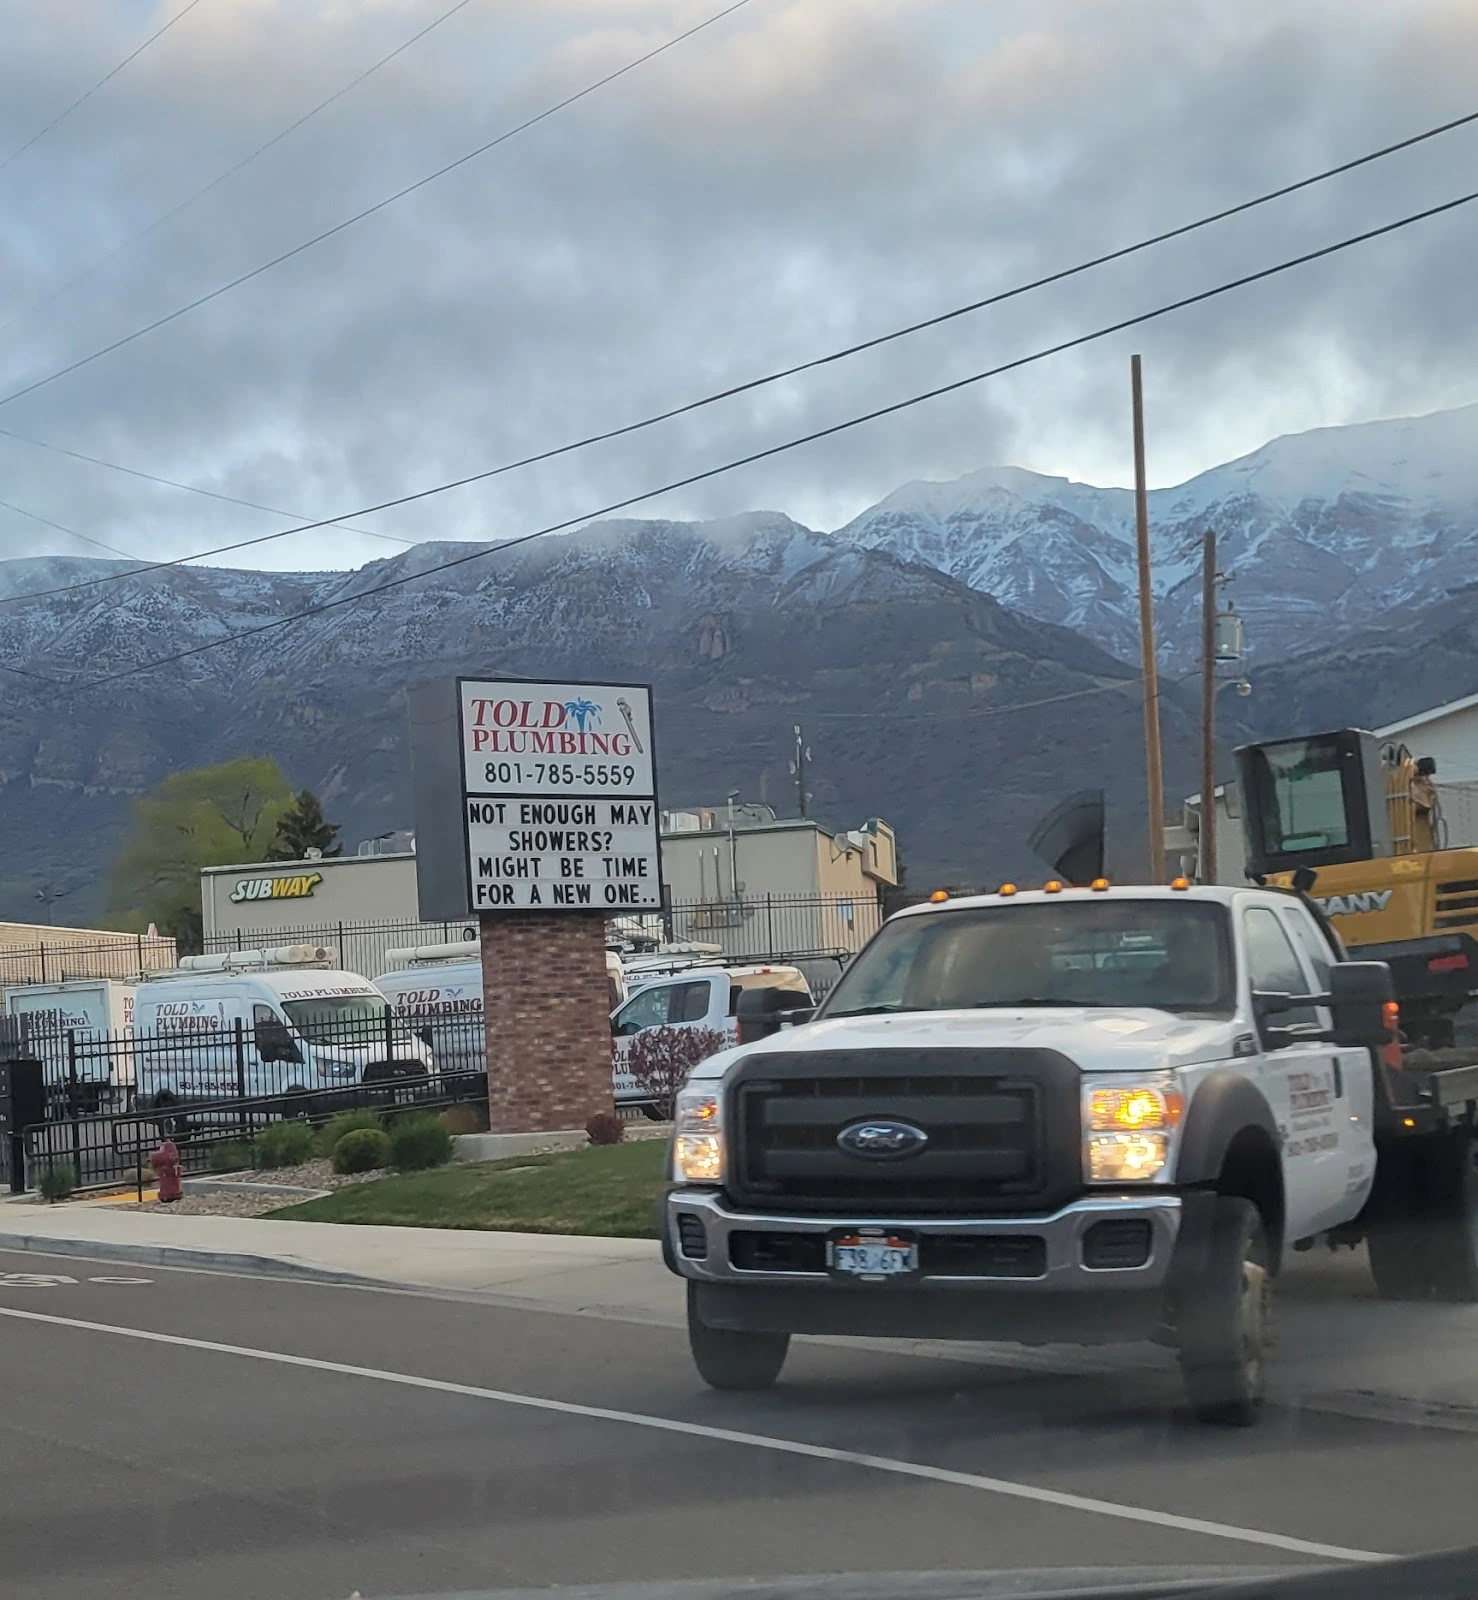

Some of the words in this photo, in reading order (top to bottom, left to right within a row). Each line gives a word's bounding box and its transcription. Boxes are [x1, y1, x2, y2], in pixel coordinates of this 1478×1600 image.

[471, 699, 567, 728] TOLD
[472, 730, 632, 756] PLUMBING
[484, 762, 635, 785] 801-785-5559
[470, 803, 506, 824] NOT
[520, 804, 596, 825] ENOUGH
[611, 805, 652, 826] MAY
[509, 830, 613, 852] SHOWERS?
[478, 857, 541, 878] MIGHT
[561, 858, 584, 877] BE
[602, 857, 648, 878] TIME
[230, 874, 321, 901] SUBWAY
[477, 884, 515, 905] FOR
[530, 884, 542, 904] A
[553, 884, 591, 904] NEW
[604, 884, 656, 904] ONE..
[281, 988, 313, 999] TOLD
[315, 987, 373, 996] PLUMBING
[397, 989, 440, 1005] TOLD
[156, 1003, 188, 1016] TOLD
[397, 998, 482, 1015] PLUMBING
[156, 1016, 219, 1029] PLUMBING
